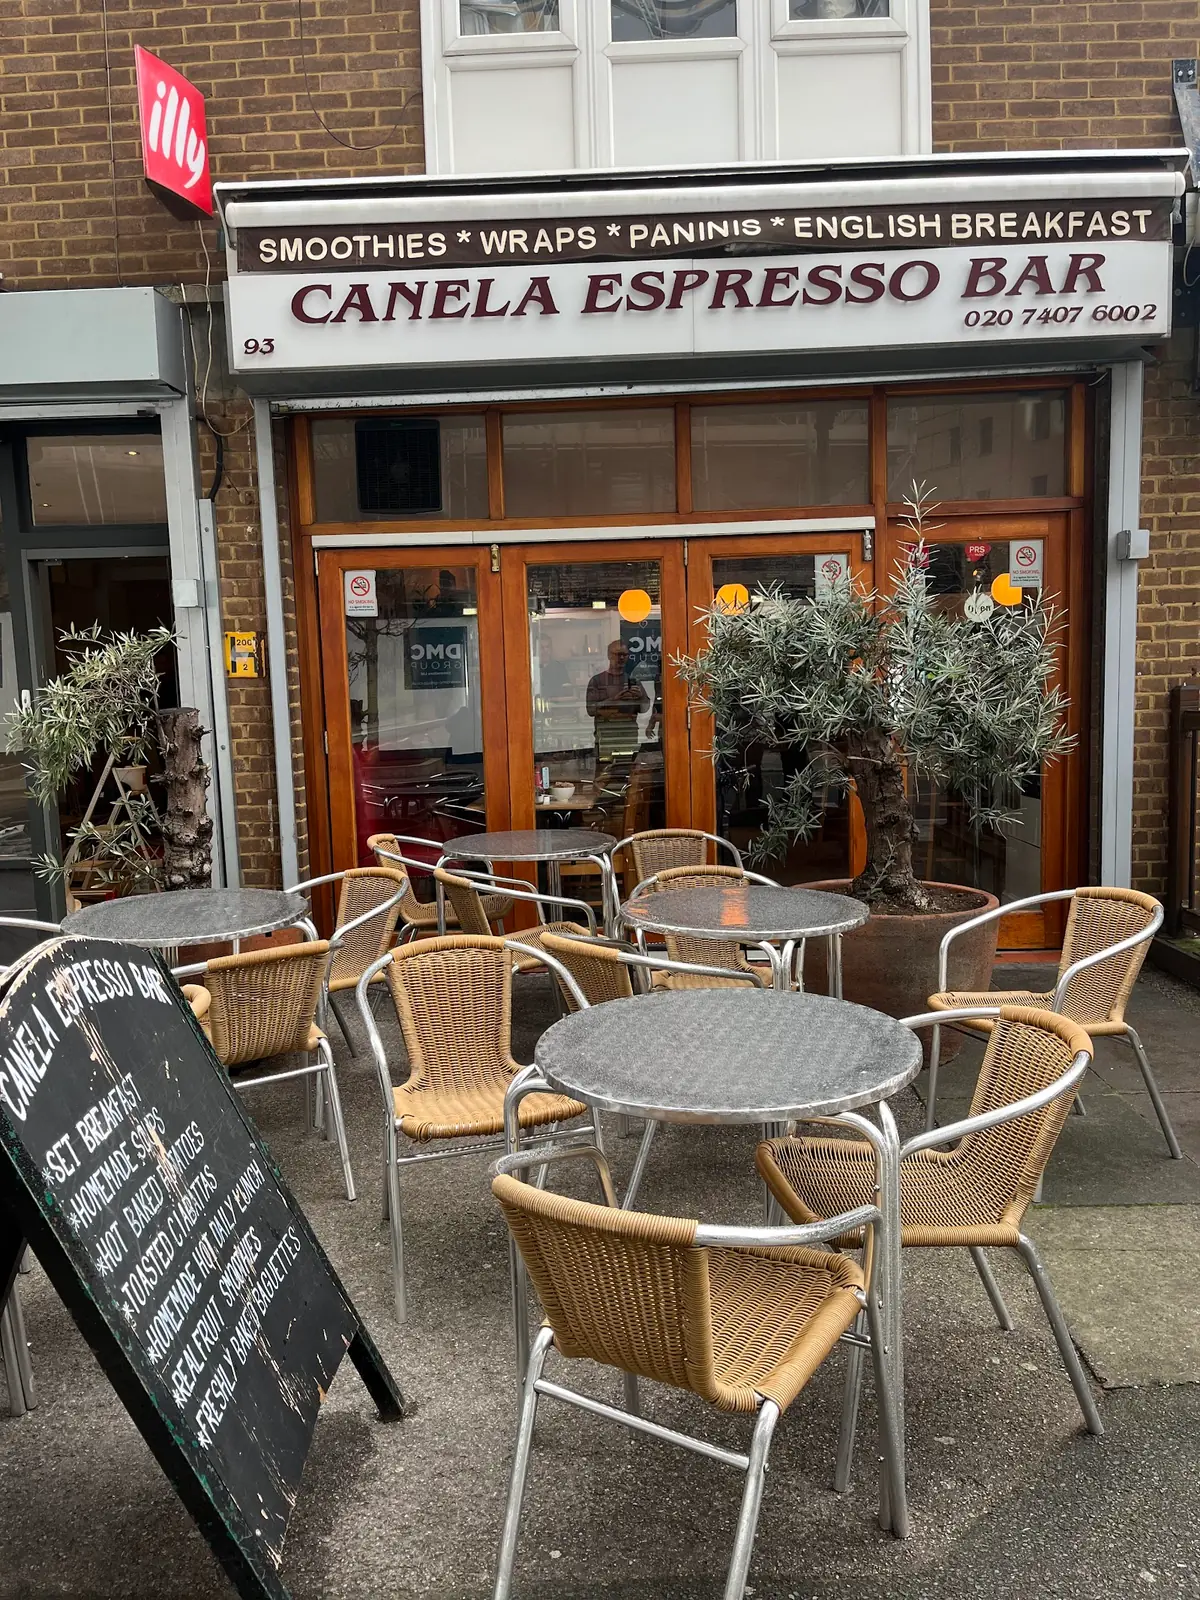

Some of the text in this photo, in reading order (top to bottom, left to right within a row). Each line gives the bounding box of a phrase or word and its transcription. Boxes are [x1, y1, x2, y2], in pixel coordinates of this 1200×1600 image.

[149, 81, 205, 189] illy
[259, 209, 1153, 263] SMOOTHIES WRAPS PANINIS ENGLISH BREAKFAST
[291, 253, 1106, 324] CANELA ESPRESSO BAR
[964, 304, 1157, 328] 020 7407 6002
[243, 338, 275, 356] 93
[969, 545, 985, 553] PRS
[0, 959, 173, 1121] CANELA ESPRESSO BAR
[46, 1072, 142, 1183] SET BREAKFAST
[70, 1141, 139, 1229] HOMEMADE
[95, 1220, 129, 1272] HOT
[122, 1175, 164, 1239] BAKED
[121, 1164, 218, 1314] TOASTED CIABATTAS
[146, 1159, 265, 1360] HOMEMADE HOT DAILY LUNCH
[171, 1343, 205, 1404] REAL
[191, 1295, 225, 1361] FRUIT
[195, 1225, 301, 1444] FRESHLY BAKED BAGUETTES
